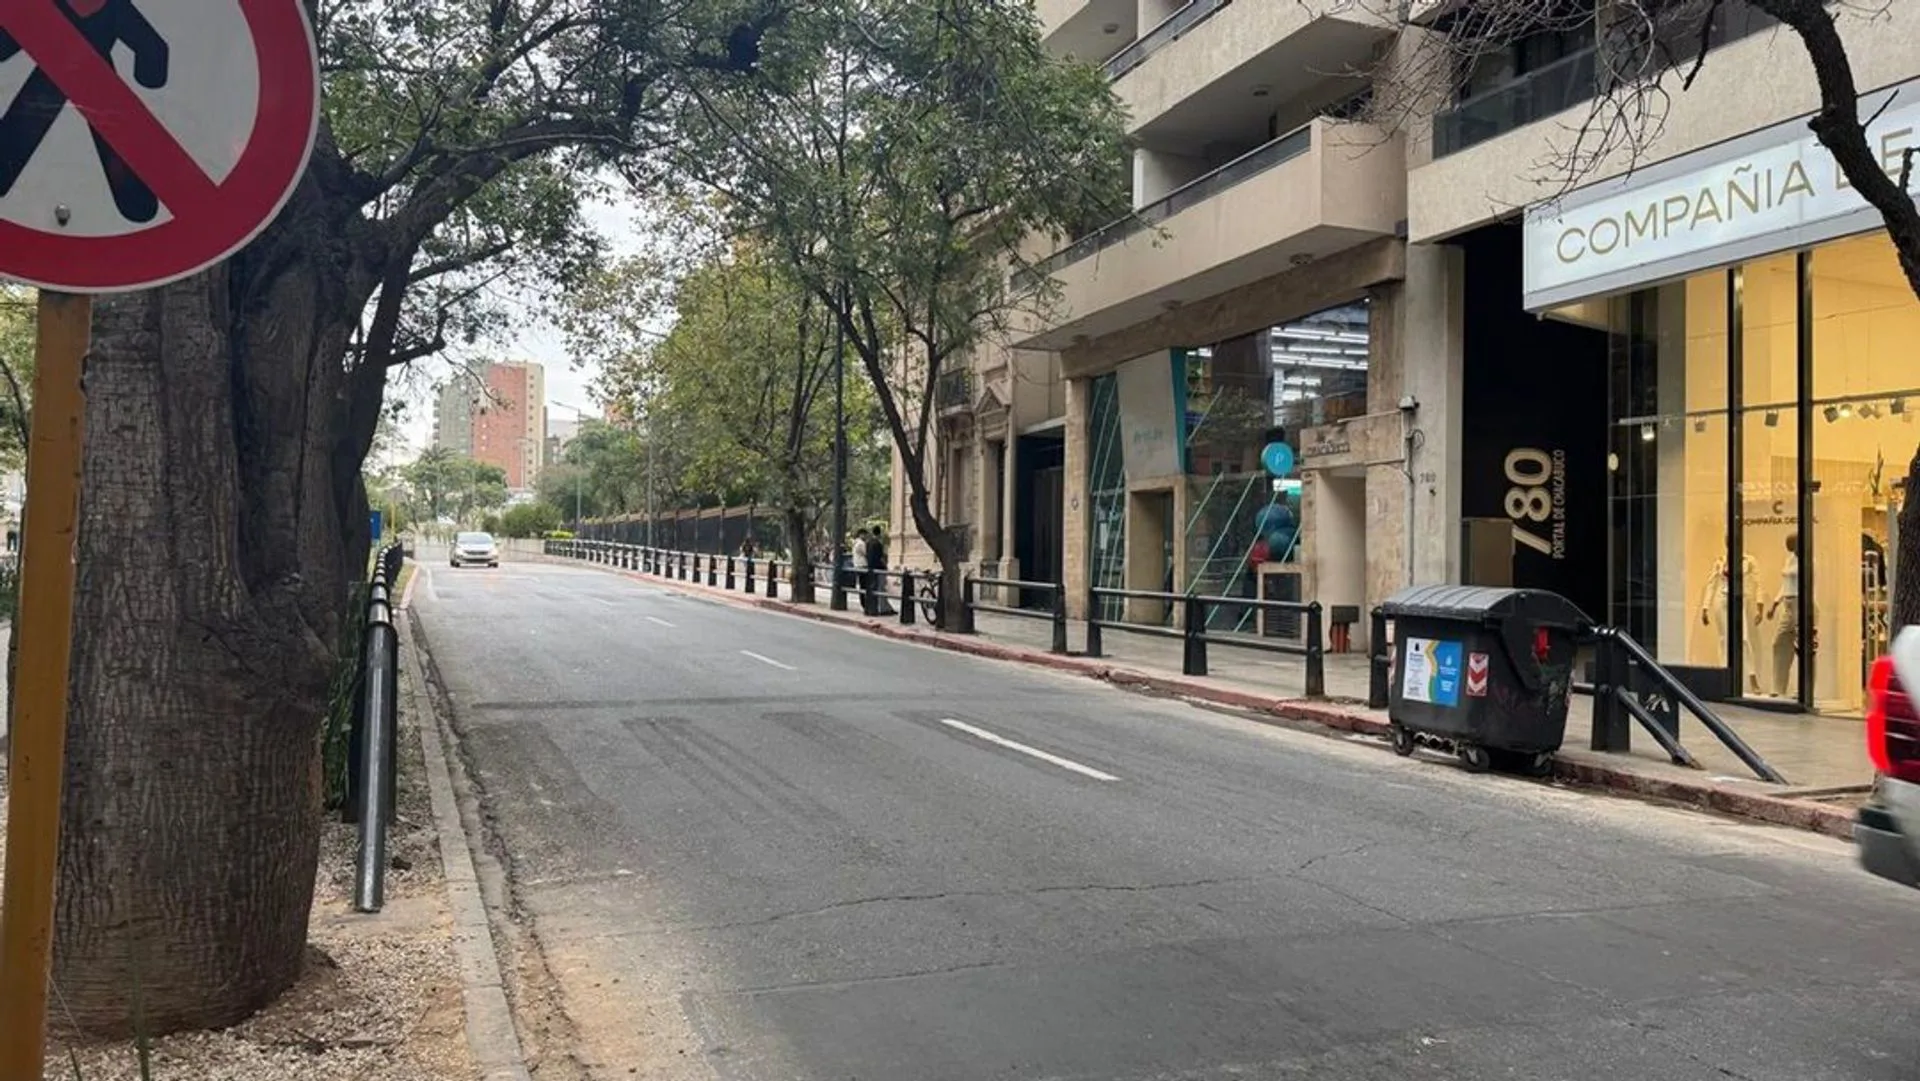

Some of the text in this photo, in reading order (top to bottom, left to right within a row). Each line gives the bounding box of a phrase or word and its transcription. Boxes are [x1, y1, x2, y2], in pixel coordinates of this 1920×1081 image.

[1556, 161, 1815, 264] COMPAÑIA
[1504, 448, 1552, 555] 780
[1552, 521, 1566, 559] PORTAL
